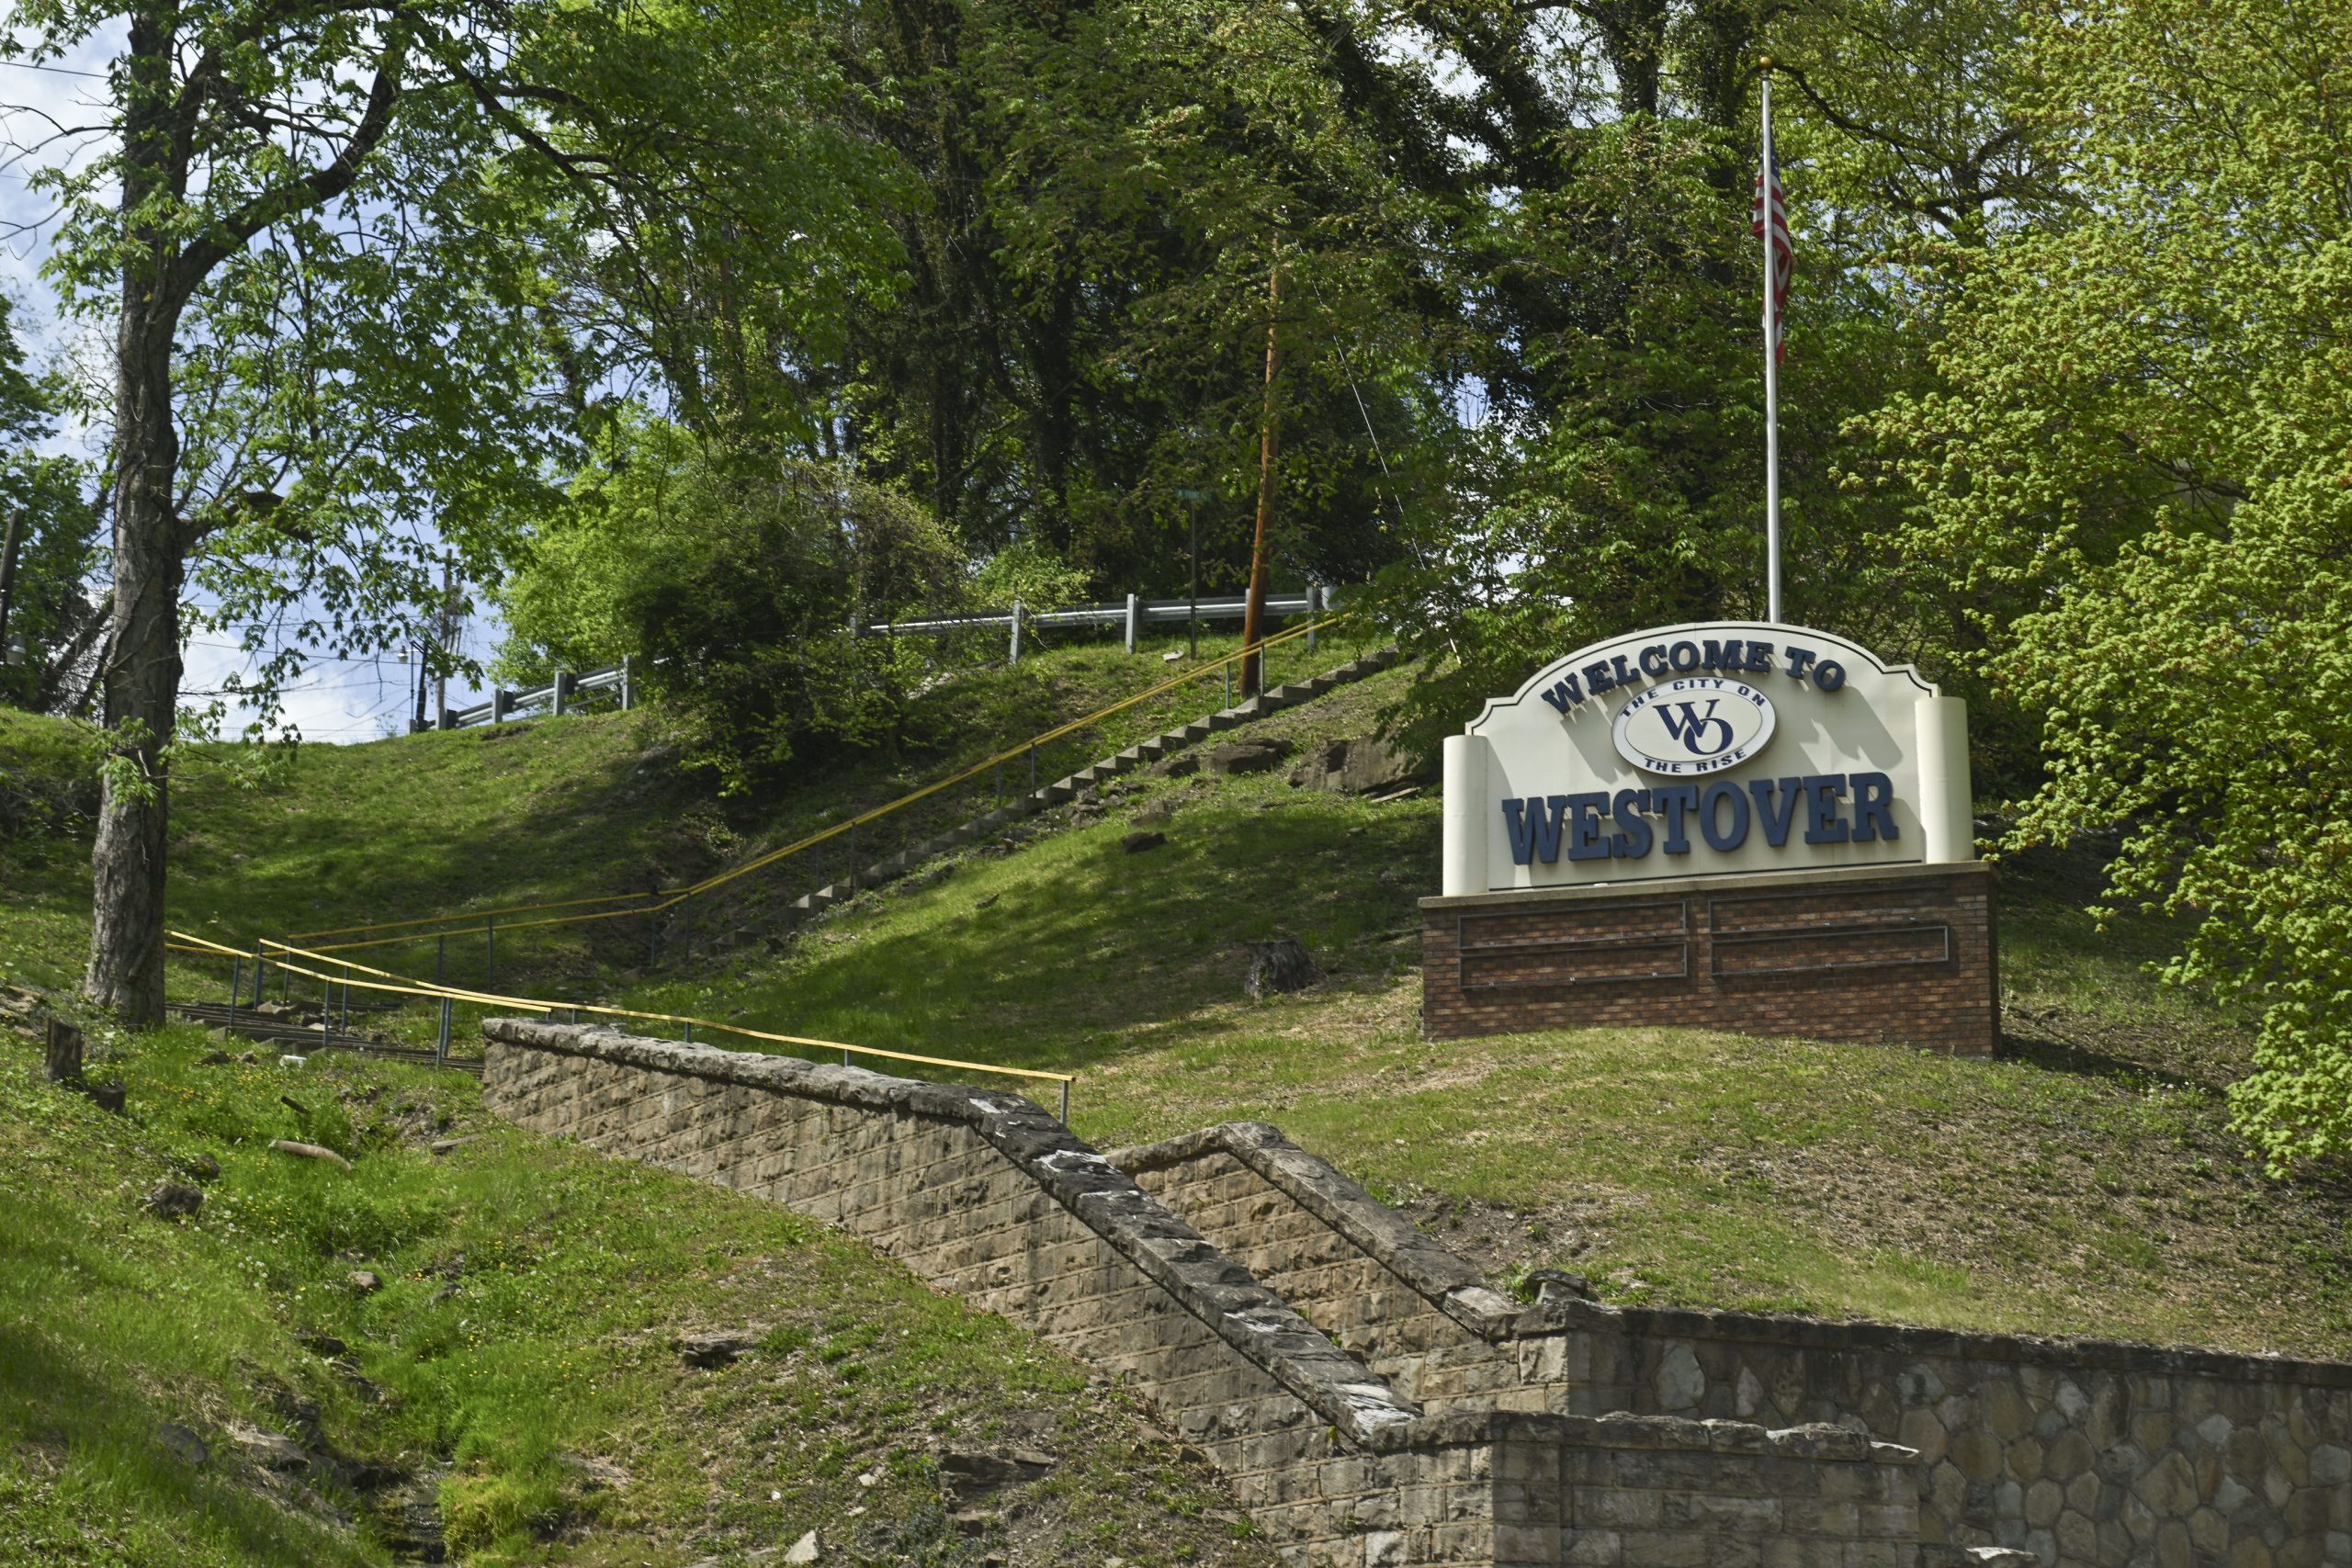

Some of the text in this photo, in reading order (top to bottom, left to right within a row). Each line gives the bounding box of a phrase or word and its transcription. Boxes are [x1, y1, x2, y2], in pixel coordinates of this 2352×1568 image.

[1541, 639, 1847, 715] WELCOME TO
[1620, 678, 1766, 718] THE CITY ON
[1644, 749, 1747, 773] THE RISE
[1501, 772, 1899, 866] WESTOVER
